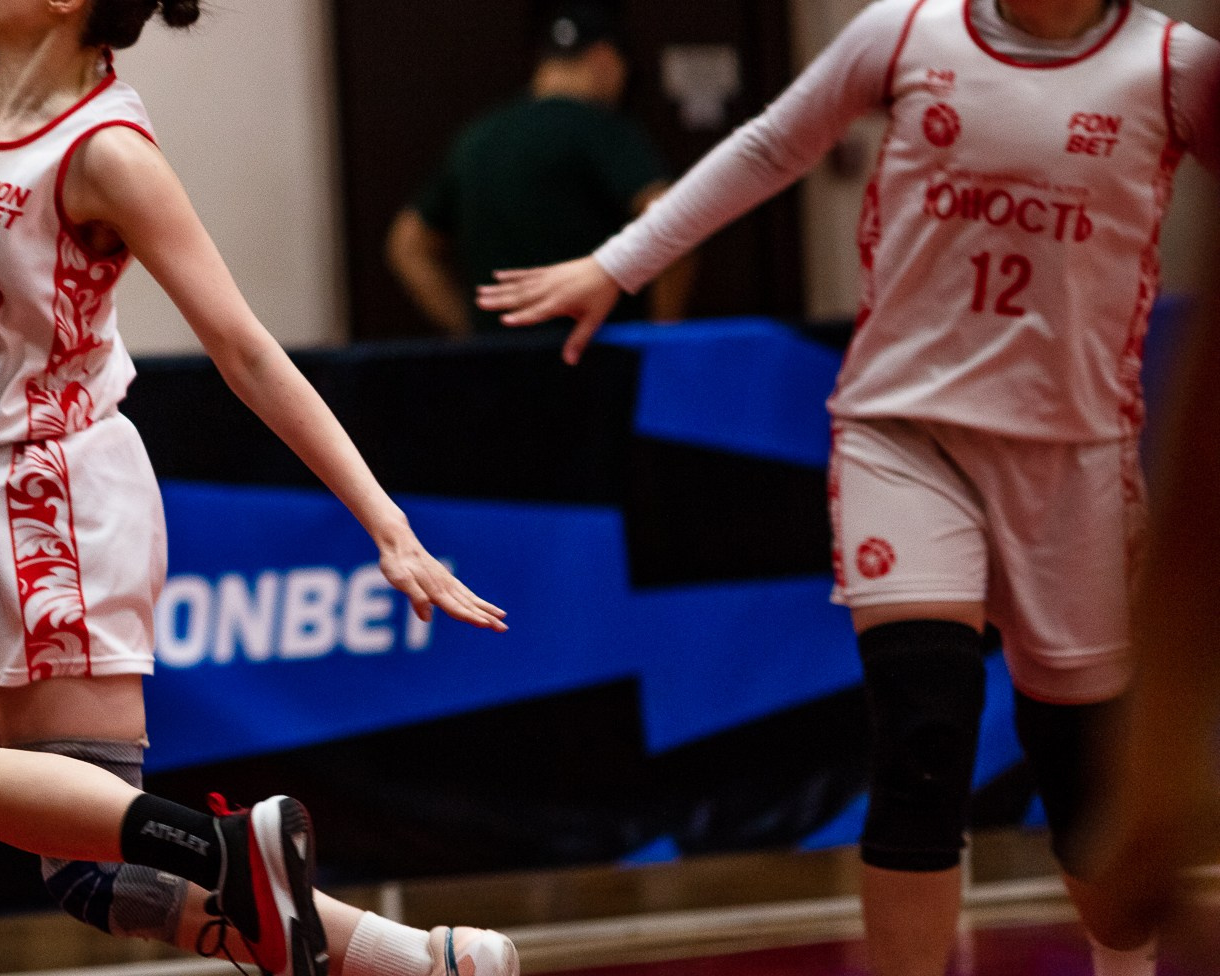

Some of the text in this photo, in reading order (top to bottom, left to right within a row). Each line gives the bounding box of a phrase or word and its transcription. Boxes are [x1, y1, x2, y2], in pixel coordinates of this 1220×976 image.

[1069, 112, 1122, 134] FON
[1066, 134, 1118, 156] BET
[970, 251, 1033, 316] 12
